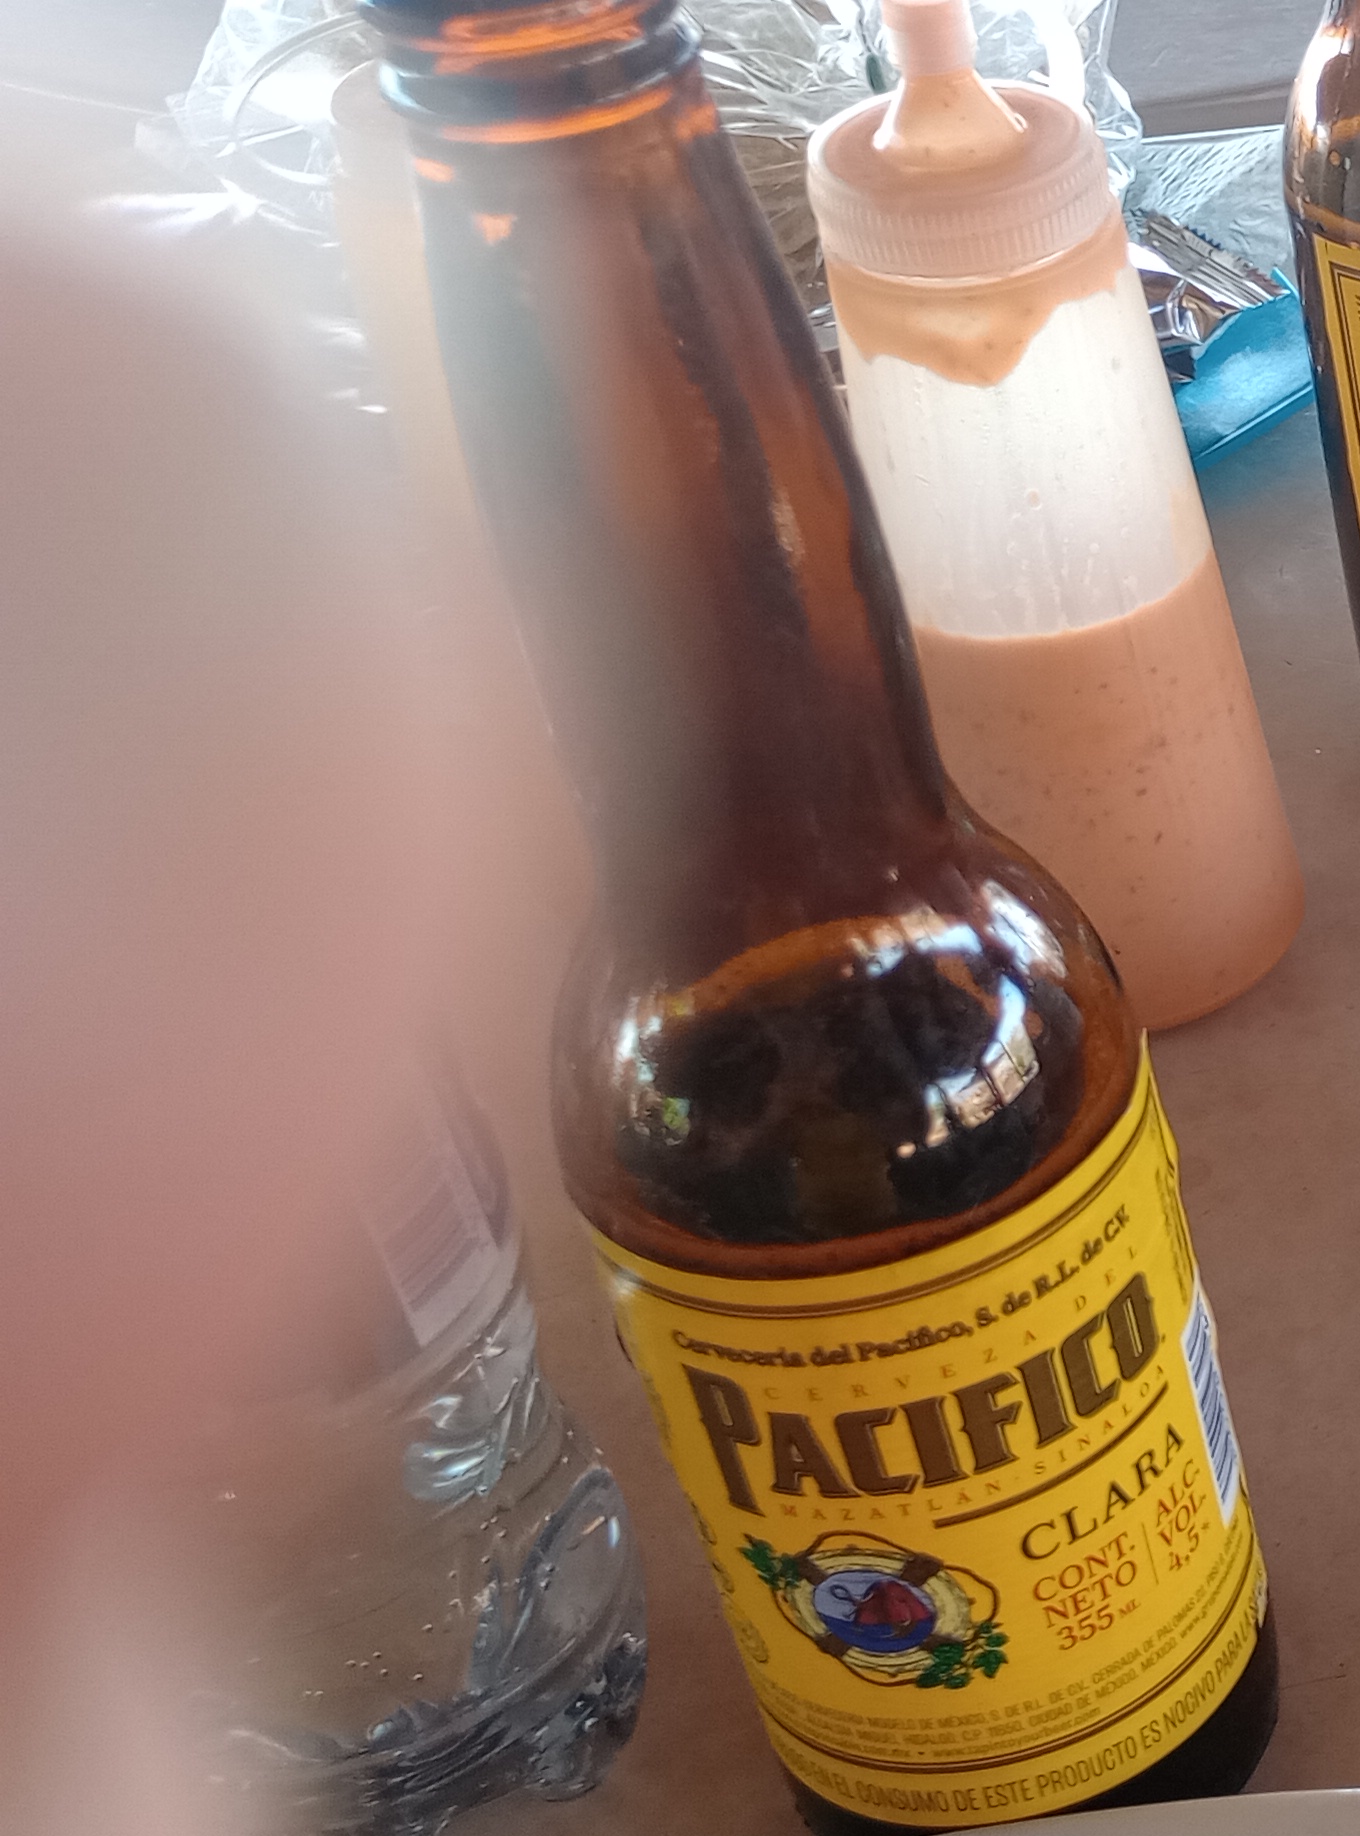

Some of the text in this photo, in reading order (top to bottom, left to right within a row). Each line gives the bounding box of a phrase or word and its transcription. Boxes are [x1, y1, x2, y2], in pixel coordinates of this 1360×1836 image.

[765, 1245, 1138, 1400] CERVEZA DEL
[810, 1342, 854, 1366] del
[1001, 1292, 1033, 1316] de
[1081, 1236, 1104, 1265] de
[680, 1271, 1160, 1517] PACIFICO
[1020, 1423, 1185, 1561] CLARA
[1033, 1531, 1136, 1602] CONT.
[1042, 1560, 1137, 1629] NETO
[1056, 1604, 1115, 1651] 355
[856, 1780, 949, 1812] CONSUMO
[951, 1788, 981, 1812] DE
[982, 1778, 1035, 1809] ESTE
[1035, 1735, 1138, 1797] PRODUCTO
[1140, 1719, 1163, 1749] ES
[1163, 1669, 1216, 1735] NOCIVO
[1214, 1630, 1243, 1684] PARA
